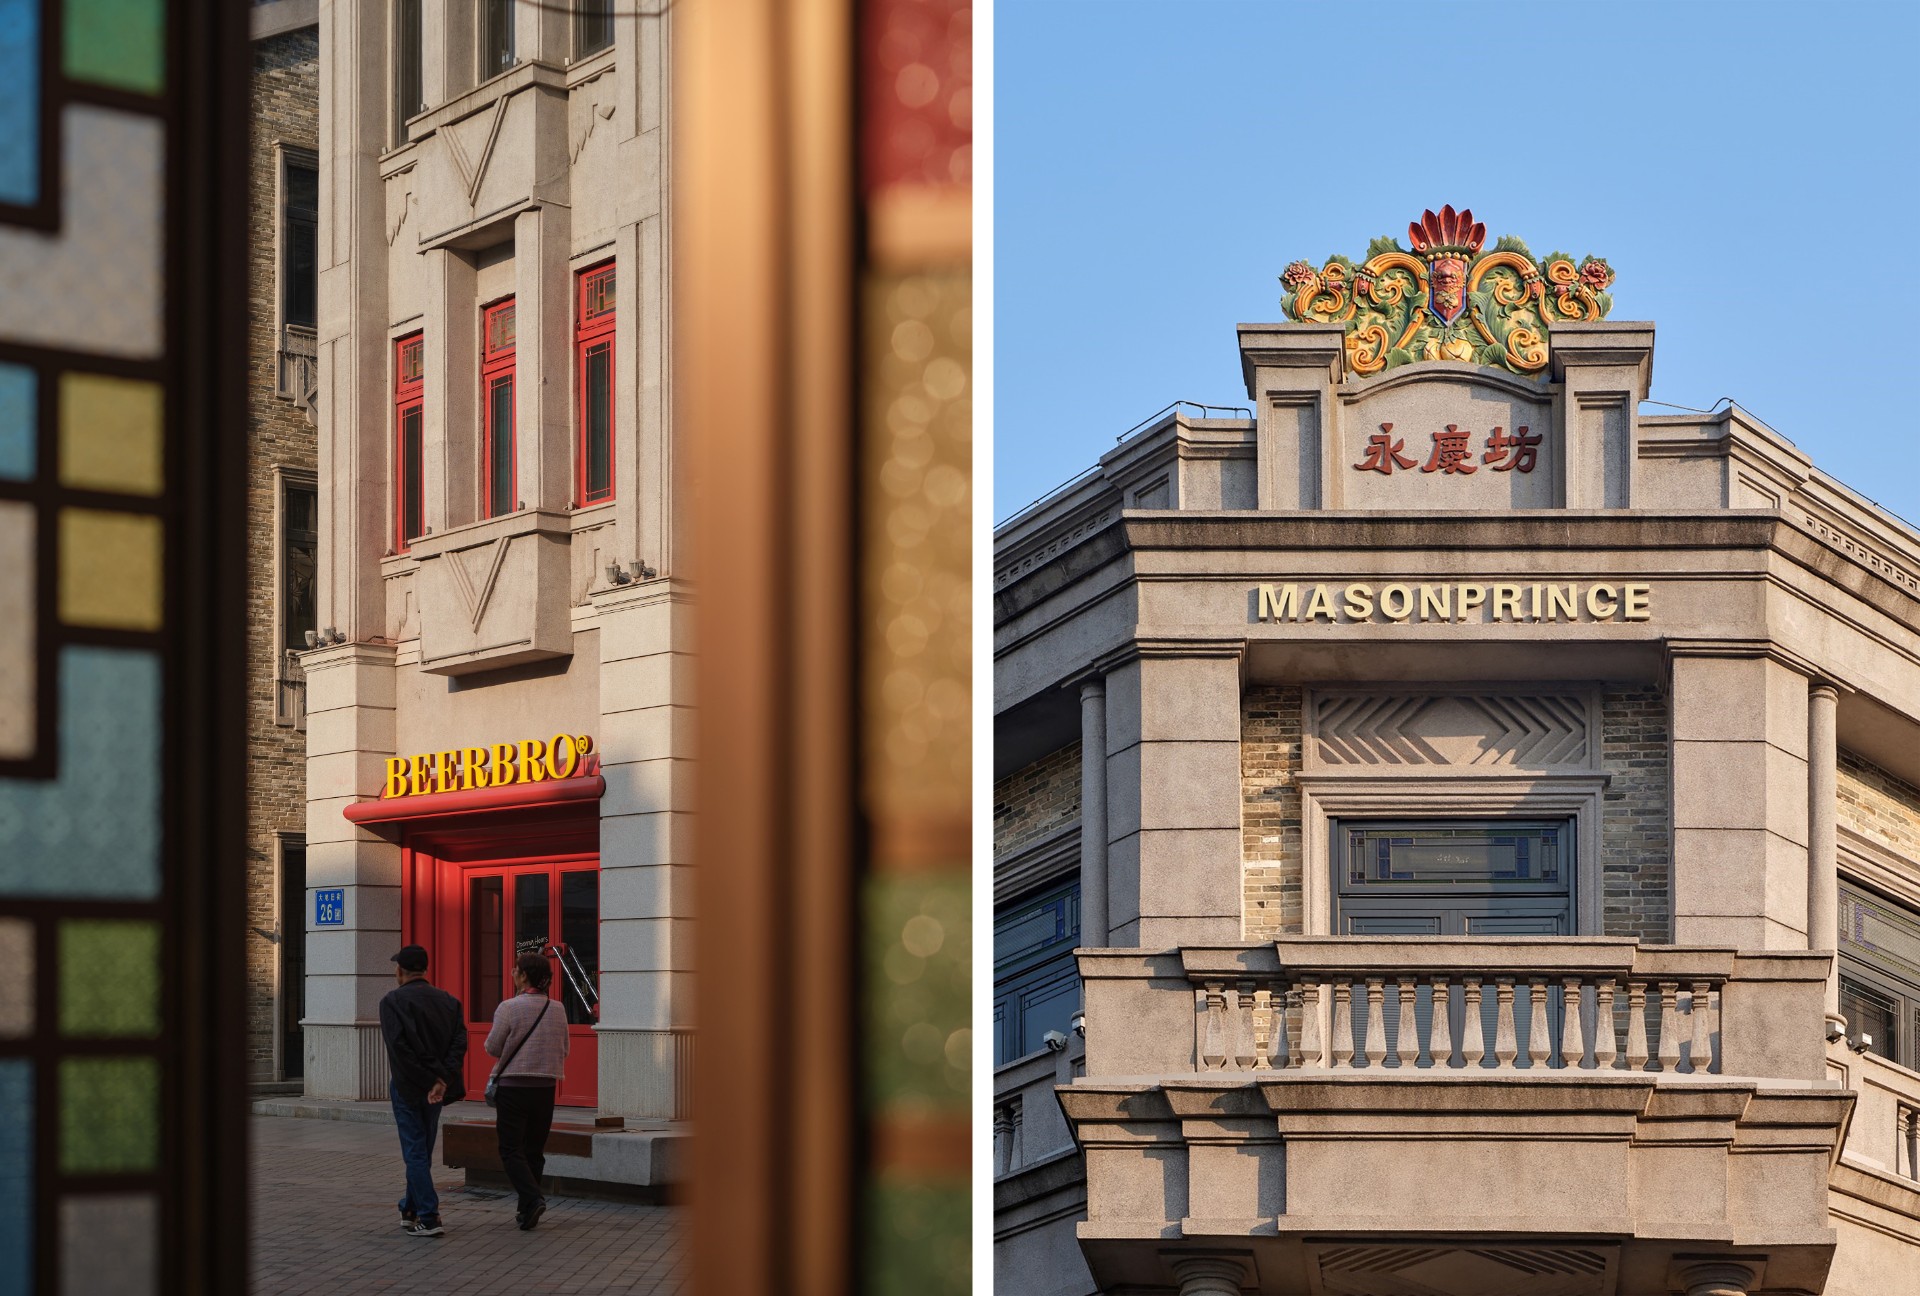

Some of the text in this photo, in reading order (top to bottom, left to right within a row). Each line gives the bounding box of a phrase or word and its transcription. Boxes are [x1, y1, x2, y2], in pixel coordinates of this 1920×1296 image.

[1353, 422, 1543, 475] 永慶坊
[1257, 583, 1651, 622] MASONPRINCE
[320, 904, 332, 921] 26
